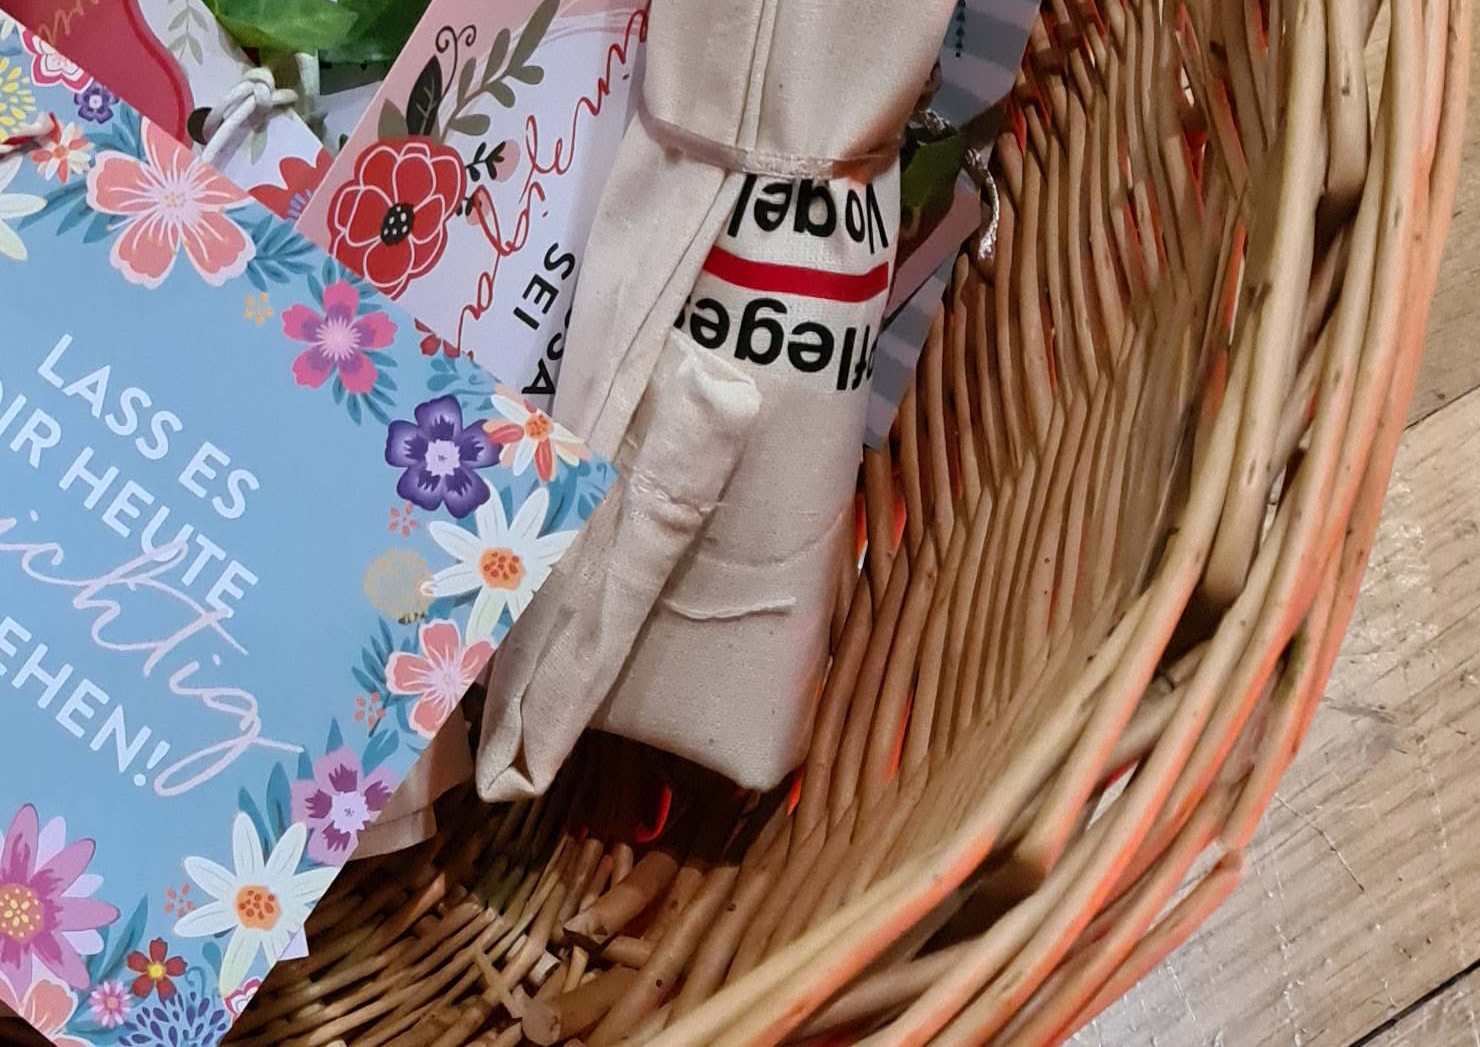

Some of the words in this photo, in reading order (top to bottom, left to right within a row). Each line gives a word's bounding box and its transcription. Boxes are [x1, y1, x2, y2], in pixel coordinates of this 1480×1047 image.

[513, 242, 576, 331] SEI
[673, 297, 875, 391] flege
[37, 334, 183, 460] LASS
[177, 441, 260, 519] ES
[59, 446, 259, 618] HEUTE
